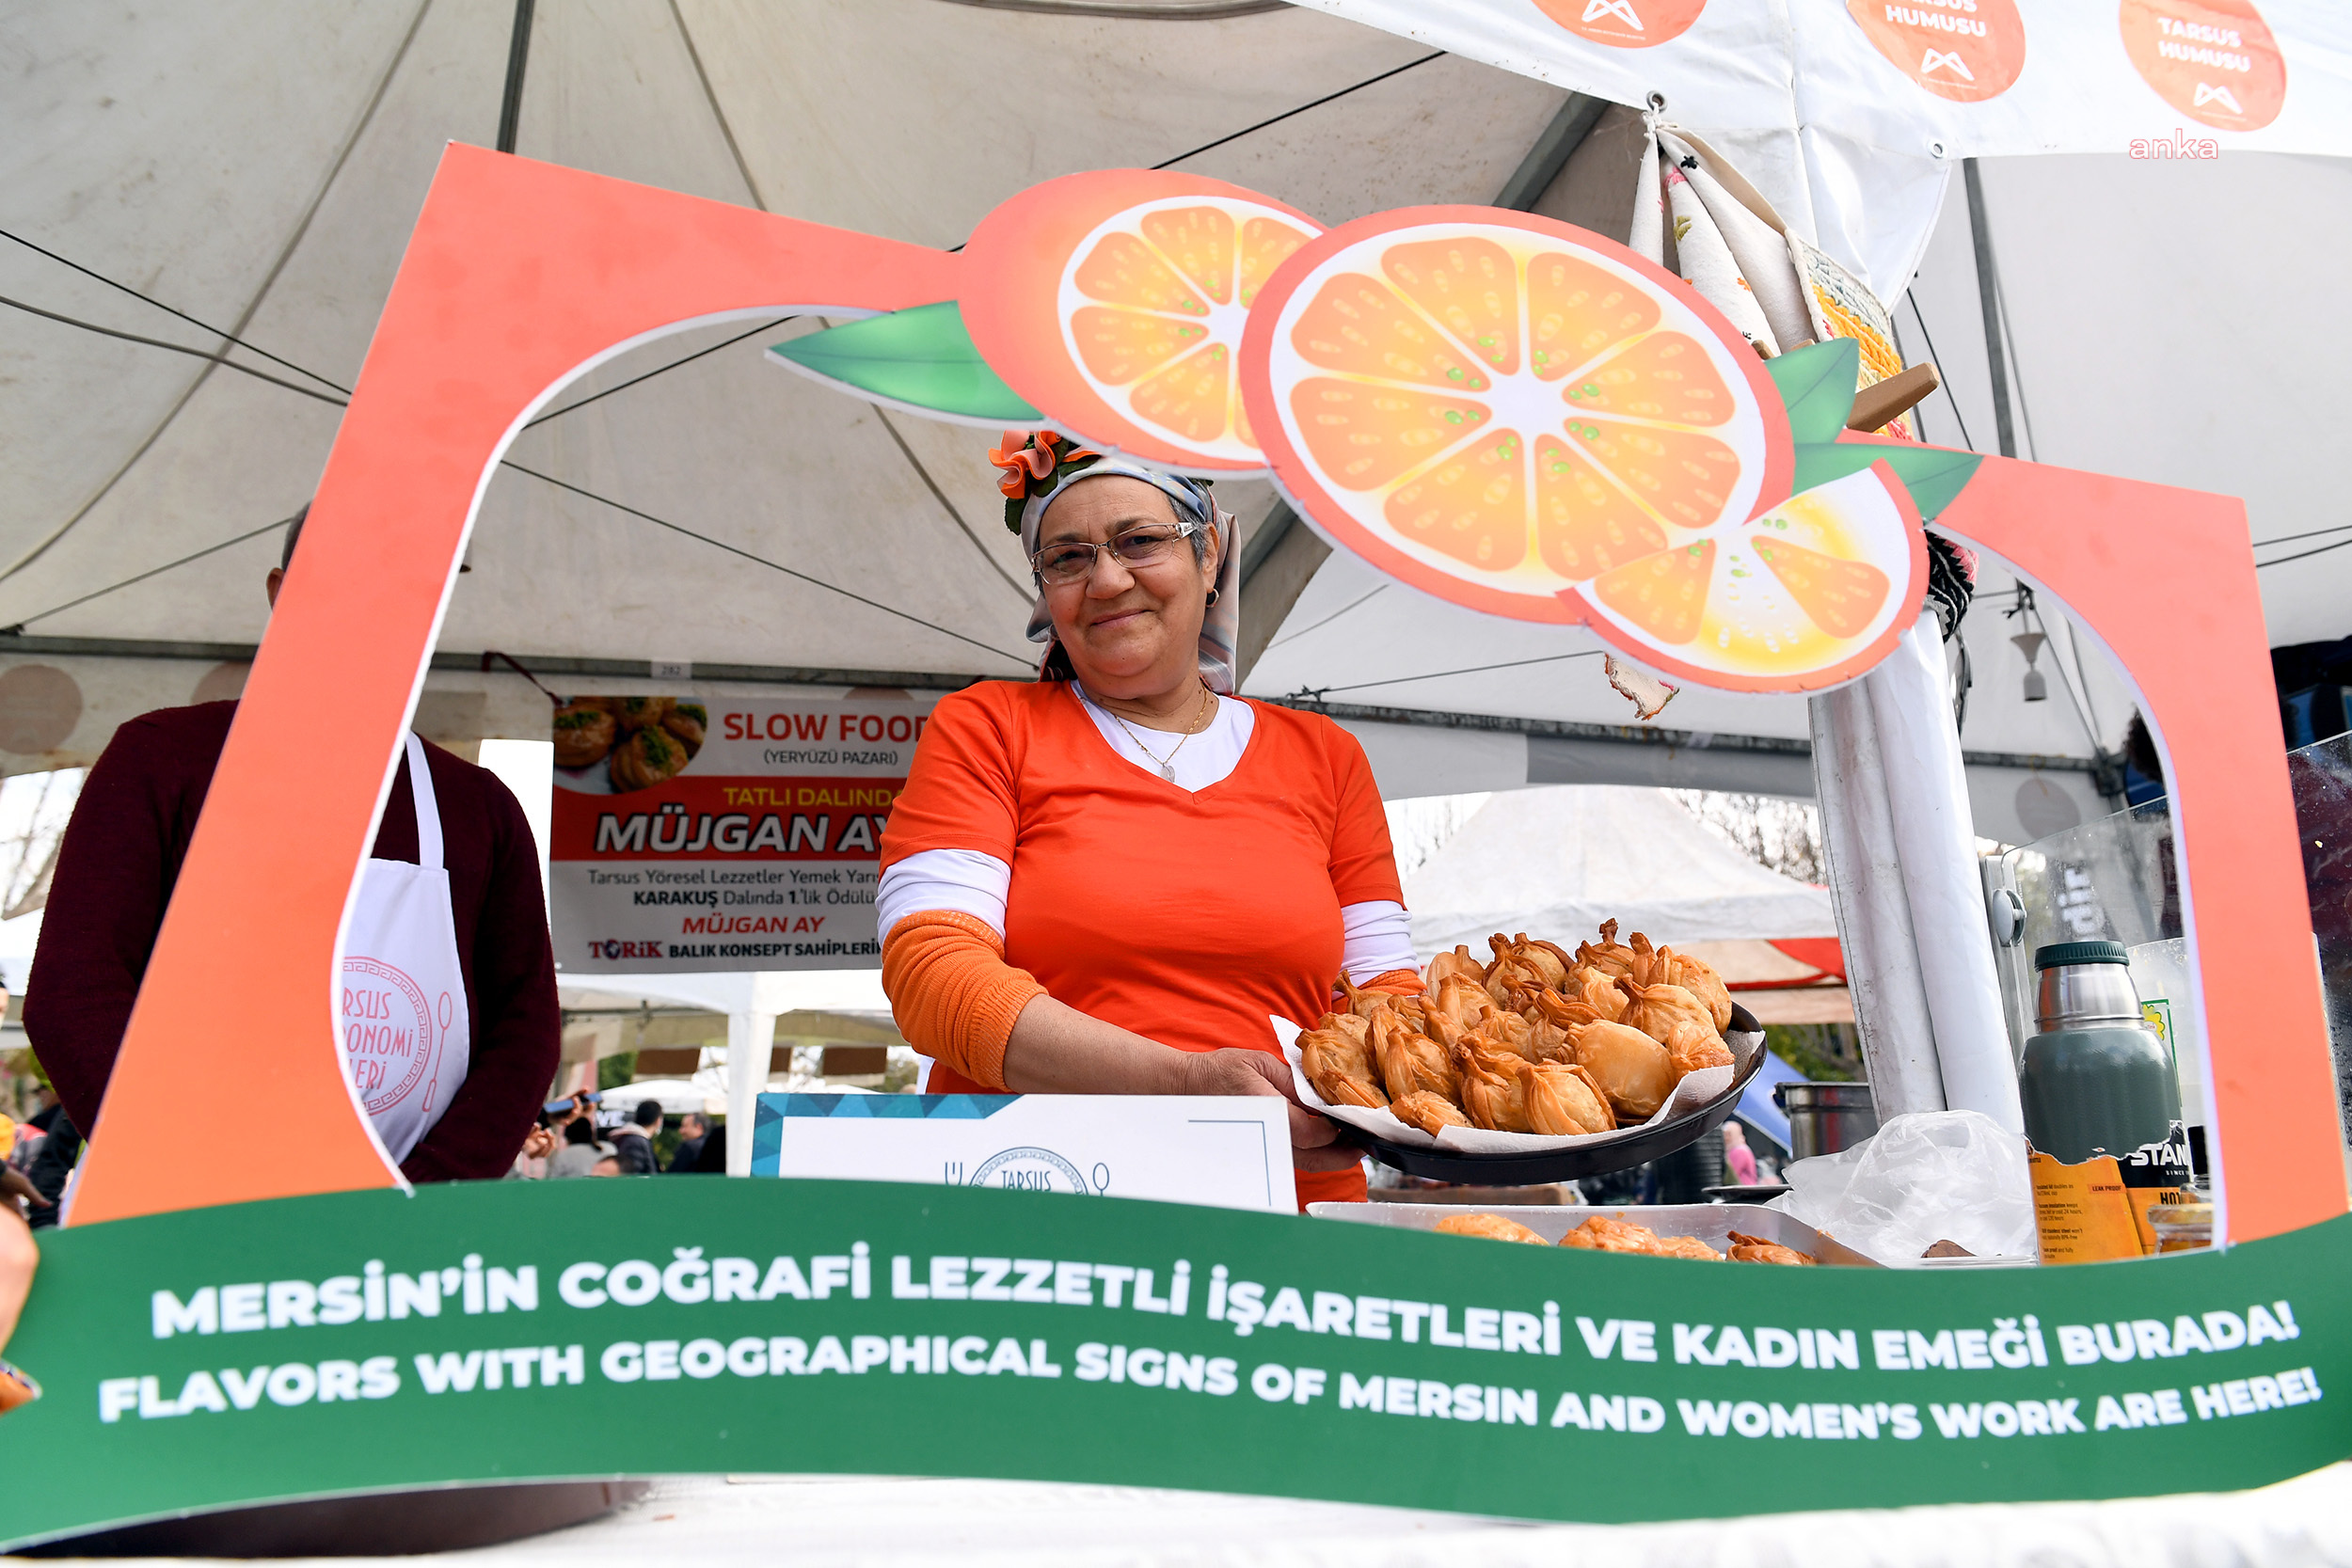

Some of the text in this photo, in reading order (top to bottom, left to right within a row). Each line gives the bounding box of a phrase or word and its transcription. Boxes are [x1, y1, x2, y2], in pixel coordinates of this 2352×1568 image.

[1884, 5, 1987, 37] HUMUSU
[2157, 17, 2242, 47] TARSUS
[2158, 40, 2251, 72] HUMUSU
[723, 713, 828, 741] SLOW
[764, 749, 898, 766] (YERYÜZÜ PAZARI)
[723, 787, 791, 806] TATLI
[595, 802, 830, 853] MÜJGAN
[588, 869, 641, 884] Tarsus
[645, 867, 706, 884] Yöresel
[711, 869, 784, 884] Lezzetler
[789, 868, 841, 884] Yemek
[633, 891, 718, 908] KARAKUŞ
[723, 891, 784, 905] Dalında
[682, 912, 826, 934] MÜJGAN AY
[670, 943, 717, 958] BALIK
[720, 942, 792, 958] KONSEPT
[2130, 1143, 2190, 1166] STAN
[1001, 1170, 1051, 1191] TARSUS
[558, 1241, 871, 1308] COĞRAFİ
[892, 1256, 1191, 1316] LEZZETLİ
[1207, 1264, 1561, 1355] İŞARETLERİ
[1575, 1317, 1658, 1362] VE
[1673, 1323, 1860, 1370] KADIN
[1871, 1314, 2048, 1370] EMEĞİ
[2057, 1300, 2299, 1366] BURADA!
[99, 1356, 401, 1422] FLAVORS
[414, 1345, 584, 1394] WITH
[600, 1336, 1062, 1383] GEOGRAPHICAL
[1074, 1342, 1238, 1396] SIGNS
[1251, 1363, 1327, 1404] OF
[1339, 1372, 1538, 1426] MERSIN
[1550, 1392, 1666, 1433] AND
[1929, 1398, 2086, 1438] WORK
[2094, 1388, 2187, 1431] ARE
[2192, 1367, 2322, 1420] HERE!
